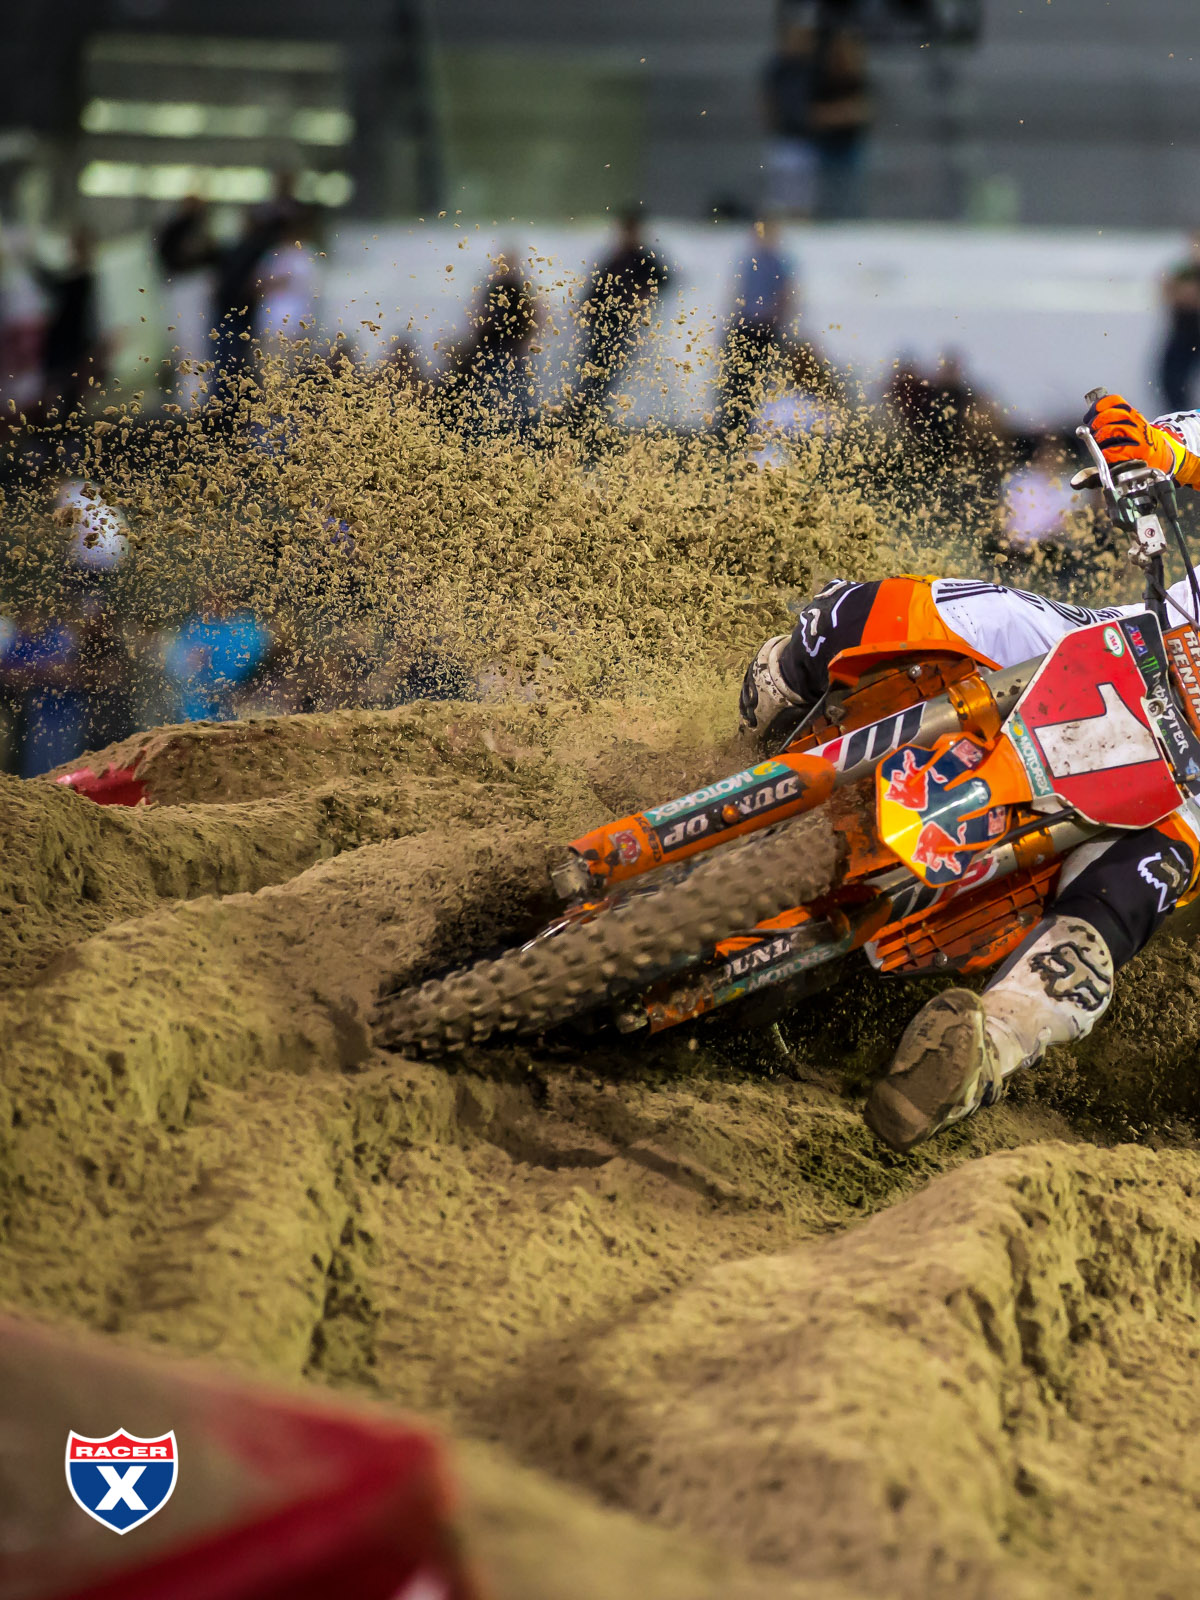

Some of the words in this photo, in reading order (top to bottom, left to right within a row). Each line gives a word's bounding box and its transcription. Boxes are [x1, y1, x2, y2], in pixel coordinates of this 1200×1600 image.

[1125, 623, 1148, 657] AMA
[1033, 682, 1161, 779] 1
[1020, 735, 1050, 795] MOTOREX
[650, 771, 754, 821] MOTOREX
[663, 775, 800, 847] DUNOP
